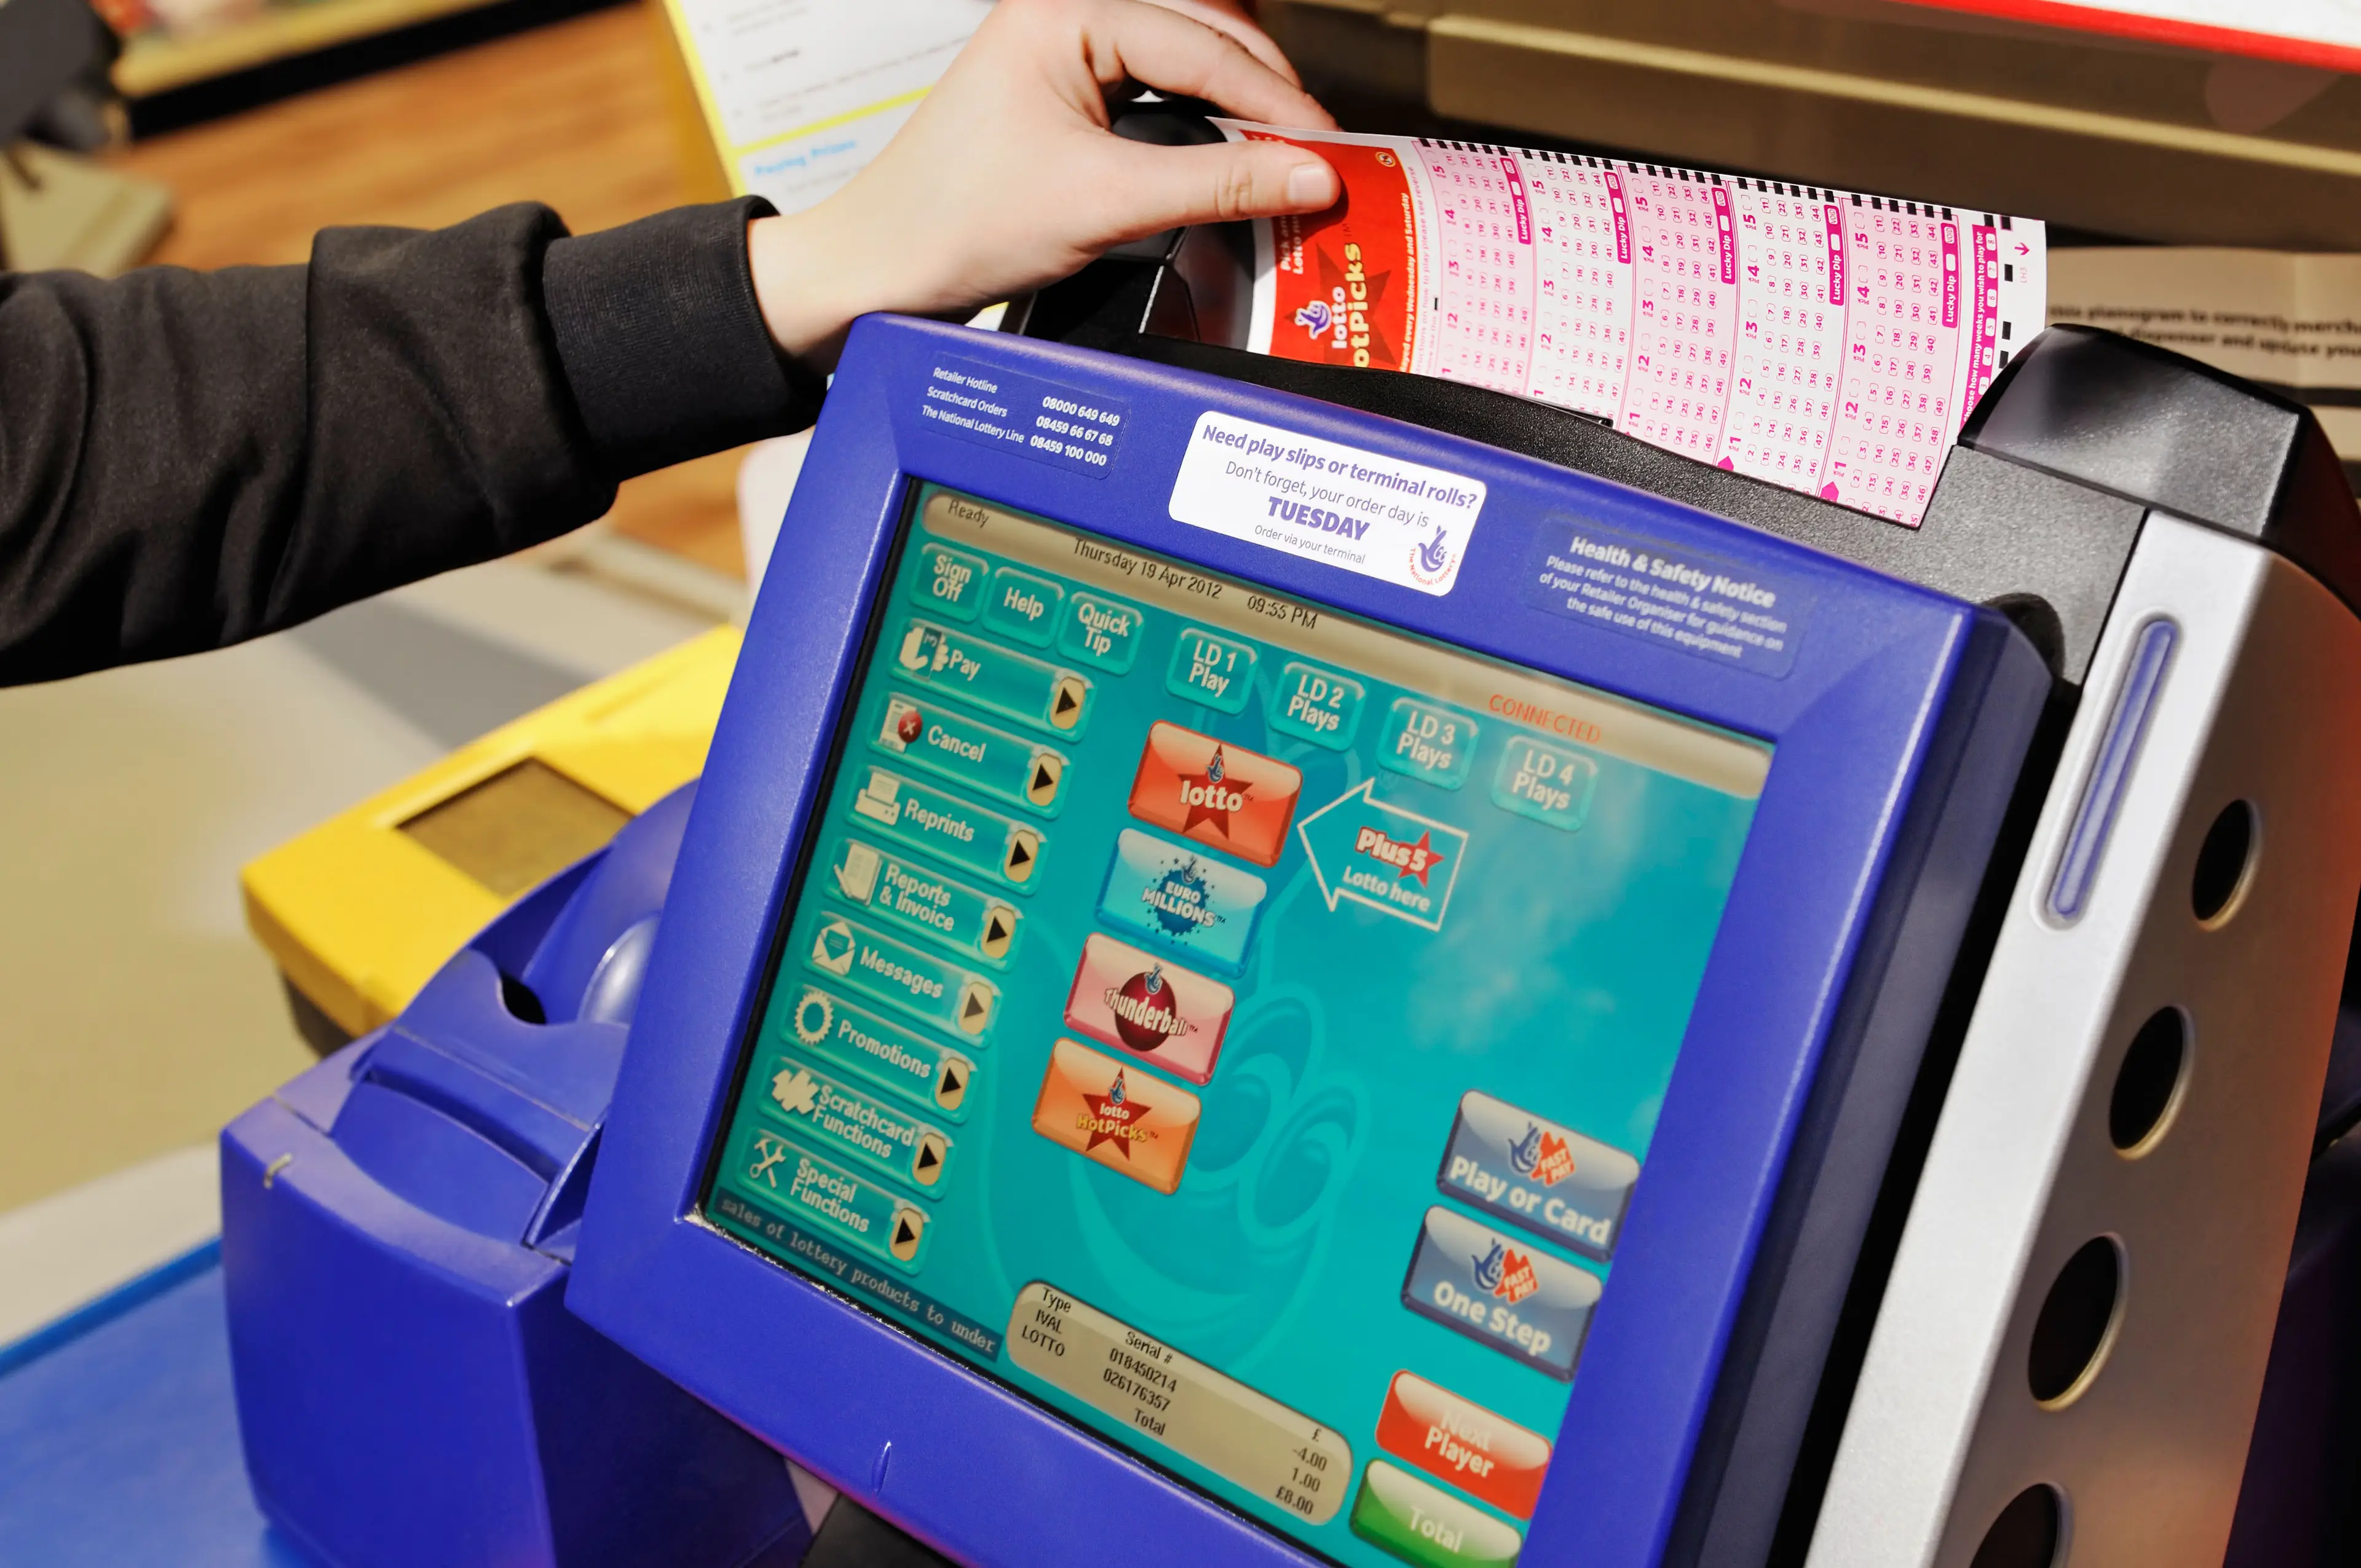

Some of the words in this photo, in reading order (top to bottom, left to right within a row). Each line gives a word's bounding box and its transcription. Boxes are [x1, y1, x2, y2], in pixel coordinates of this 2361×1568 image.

[1401, 193, 1414, 234] Saturday
[1405, 236, 1414, 255] and
[1977, 246, 1985, 263] play
[1406, 256, 1415, 312] Wednesday
[1977, 264, 1984, 274] to
[1332, 286, 1347, 349] lotto
[1404, 313, 1415, 342] every
[1973, 344, 1982, 368] many
[933, 367, 967, 385] Retailer
[967, 376, 997, 393] Hotline
[1969, 369, 1978, 388] how
[927, 386, 978, 410] Scratchcard
[978, 400, 1007, 417] Orders
[1042, 396, 1077, 415] 08000
[1078, 406, 1098, 421] 649
[1099, 412, 1120, 427] 649
[922, 404, 937, 418] The
[938, 410, 973, 429] National
[975, 420, 1005, 439] Lottery
[1006, 429, 1024, 443] Line
[1036, 416, 1069, 435] 08459
[1069, 425, 1084, 438] 66
[1085, 430, 1098, 442] 67
[1099, 433, 1113, 446] 68
[1030, 435, 1063, 454] 08459
[1065, 444, 1084, 460] 100
[1085, 451, 1107, 467] 000
[1203, 425, 1246, 449] Need
[1246, 436, 1285, 462] play
[1287, 447, 1324, 470] slips
[1328, 459, 1349, 476] or
[1350, 465, 1426, 497] terminal
[1427, 486, 1477, 510] rolls?
[1225, 460, 1264, 484] Don't
[1264, 471, 1308, 496] forget,
[1311, 485, 1344, 505] your
[1346, 494, 1386, 517] order
[1388, 504, 1415, 527] day
[1417, 511, 1429, 527] is
[948, 499, 989, 528] Ready
[1267, 495, 1370, 542] TUESDAY
[1255, 524, 1282, 543] Order
[1283, 532, 1297, 546] via
[1297, 535, 1323, 553] your
[1323, 542, 1366, 564] terminal
[933, 554, 972, 584] Sign
[1074, 537, 1137, 575] Thursday
[1140, 562, 1157, 578] 19
[1158, 567, 1185, 589] Apr
[1187, 577, 1222, 600] 2012
[1570, 536, 1630, 568] Health
[1631, 554, 1648, 573] &
[1649, 558, 1712, 593] Safety
[1710, 575, 1776, 608] Notice
[932, 578, 962, 602] Off
[1003, 586, 1044, 621] Help
[1546, 555, 1584, 577] Please
[1584, 566, 1615, 585] refer
[1615, 575, 1629, 589] to
[1629, 578, 1650, 595] the
[1650, 585, 1690, 606] health
[1690, 596, 1701, 609] &
[1699, 599, 1741, 621] safety
[1739, 611, 1787, 633] section
[1078, 602, 1131, 637] Quick
[1247, 595, 1287, 621] 09:55
[1291, 606, 1319, 630] PM
[1539, 573, 1554, 585] of
[1552, 577, 1581, 593] your
[1581, 583, 1627, 606] Retailer
[1627, 596, 1687, 623] Organiser
[1687, 613, 1707, 628] for
[1706, 620, 1765, 647] guidance
[1765, 637, 1784, 651] on
[1567, 596, 1587, 613] the
[1587, 604, 1613, 620] safe
[1613, 613, 1635, 628] use
[1635, 617, 1652, 631] of
[1650, 621, 1674, 639] this
[1674, 630, 1743, 658] equipment
[1085, 626, 1112, 656] Tip
[1193, 640, 1222, 666] LD
[1226, 652, 1238, 672] 1
[949, 650, 981, 681] Pay
[1188, 664, 1230, 698] Play
[1297, 674, 1326, 701] LD
[1329, 687, 1345, 709] 2
[1287, 696, 1340, 732] Plays
[1407, 711, 1438, 739] LD
[1443, 723, 1456, 746] 3
[1489, 693, 1601, 744] CONNECTED
[927, 725, 986, 763] Cancel
[1396, 732, 1452, 770] Plays
[1523, 749, 1556, 778] LD
[1559, 763, 1575, 786] 4
[1179, 780, 1244, 812] lotto
[1513, 772, 1571, 811] Plays
[904, 798, 975, 842] Reprints
[884, 864, 951, 907] Reports
[1165, 881, 1201, 905] EURO
[1342, 866, 1390, 897] Lotto
[1390, 885, 1431, 912] here
[879, 886, 893, 905] &
[895, 891, 955, 932] Invoice
[1141, 888, 1215, 928] MILLIONS
[860, 947, 943, 999] Messages
[1104, 987, 1188, 1037] Thunderball
[837, 1020, 931, 1079] Promotions
[819, 1084, 916, 1146] Scratchcard
[1077, 1113, 1147, 1143] HotPicks
[1099, 1101, 1130, 1121] lotto
[812, 1106, 892, 1158] Functions
[1540, 1149, 1569, 1170] FAST
[1549, 1161, 1573, 1184] PAY
[797, 1158, 857, 1204] Special
[1450, 1155, 1506, 1204] Play
[1509, 1184, 1542, 1213] or
[1544, 1199, 1612, 1245] Card
[790, 1177, 869, 1232] Functions
[721, 1198, 761, 1227] sales
[765, 1223, 785, 1240] of
[789, 1231, 848, 1275] lottery
[851, 1268, 920, 1312] products
[926, 1304, 944, 1325] to
[952, 1320, 995, 1353] under
[1043, 1288, 1071, 1314] Type
[1125, 1331, 1161, 1360] Serial
[1433, 1281, 1486, 1323] One
[1489, 1307, 1551, 1356] Step
[1021, 1325, 1065, 1357] LOTTO
[1103, 1369, 1171, 1412] 026176357
[1292, 1468, 1320, 1492] 1.00
[1035, 1309, 1062, 1334] IVAL
[1109, 1348, 1177, 1393] 018450214
[1292, 1446, 1327, 1471] -4.00
[1439, 1409, 1491, 1452] Next
[1134, 1408, 1166, 1436] Total
[1275, 1486, 1314, 1516] £8.00
[1425, 1428, 1494, 1477] Player
[1410, 1506, 1463, 1553] Total
